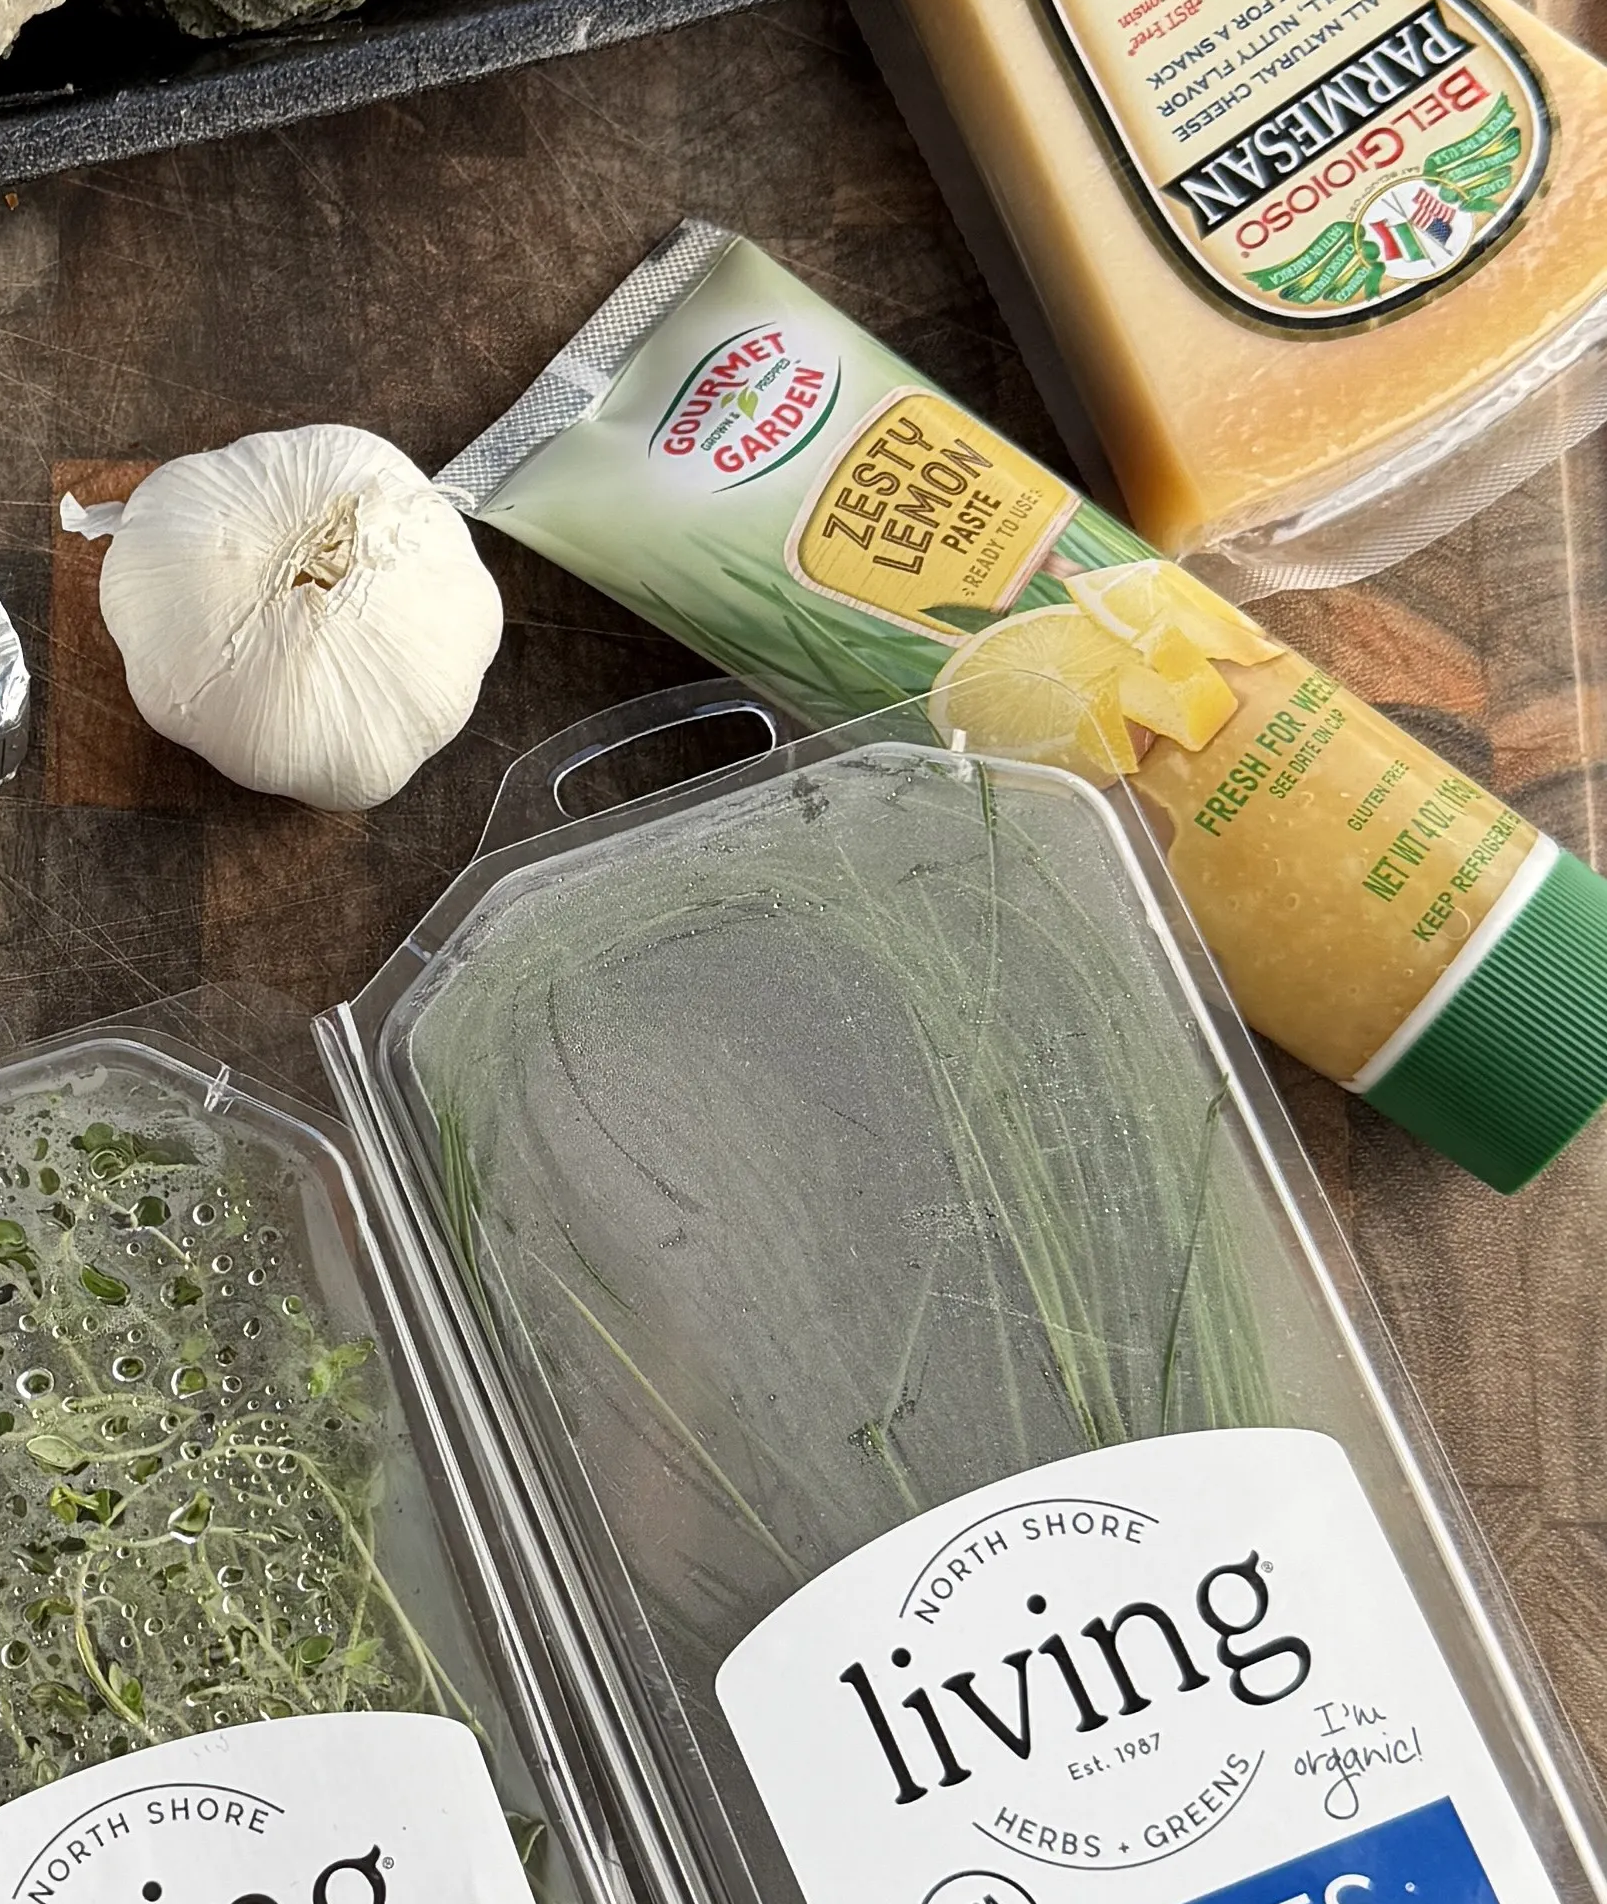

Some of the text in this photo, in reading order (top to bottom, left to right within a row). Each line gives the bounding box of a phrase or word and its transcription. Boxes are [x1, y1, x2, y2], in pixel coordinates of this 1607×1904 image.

[1145, 36, 1217, 91] SNACK
[1213, 24, 1231, 42] A
[1237, 14, 1301, 66] NUTTY
[1249, 21, 1346, 85] NATURAL
[1156, 61, 1236, 119] FLAVOR
[1171, 83, 1253, 144] CHEESE
[1178, 10, 1465, 226] PARMESAN
[662, 331, 787, 457] GOURMET
[699, 417, 736, 452] GROWN
[754, 357, 792, 392] PREPPED
[712, 366, 826, 474] GARDEN
[822, 416, 935, 551] ZESTY
[872, 438, 994, 576] LEMON
[939, 489, 1003, 556] PASTE
[965, 493, 1038, 589] READY TO USE
[1193, 710, 1307, 837] FRESH FOR
[1347, 759, 1410, 832] GLUTEN FREE
[913, 1511, 1147, 1626] NORTH SHORE
[839, 1548, 1312, 1807] living
[1313, 1700, 1389, 1739] I'm
[1067, 1731, 1164, 1783] Est. 1987
[1292, 1726, 1424, 1820] organic!
[145, 1798, 271, 1837] SHORE
[992, 1805, 1103, 1859] HERBS
[1143, 1752, 1252, 1851] GREENS
